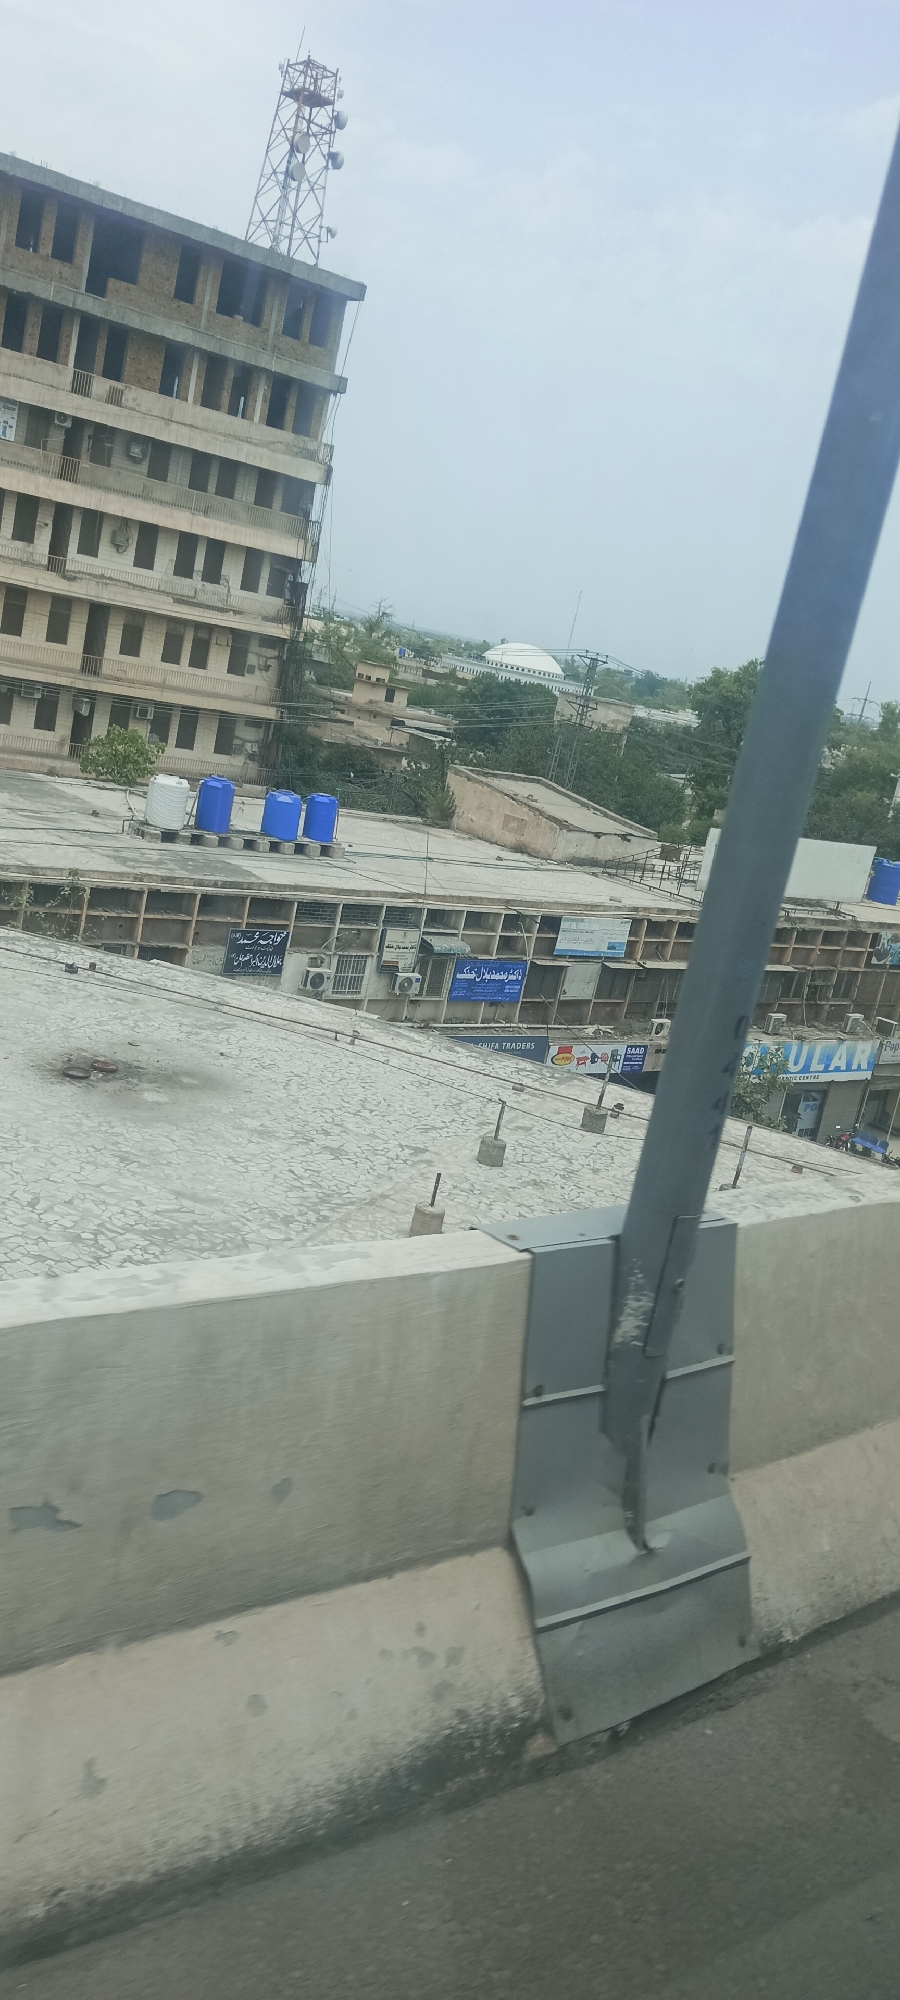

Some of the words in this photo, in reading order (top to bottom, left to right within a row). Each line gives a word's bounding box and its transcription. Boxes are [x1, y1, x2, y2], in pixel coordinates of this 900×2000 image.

[236, 931, 260, 945] محمد
[475, 966, 491, 982] بلال
[490, 969, 508, 981] محمد
[504, 969, 523, 983] ڈاکٹر
[502, 1042, 535, 1050] TRADERS
[626, 1047, 645, 1055] SAAD
